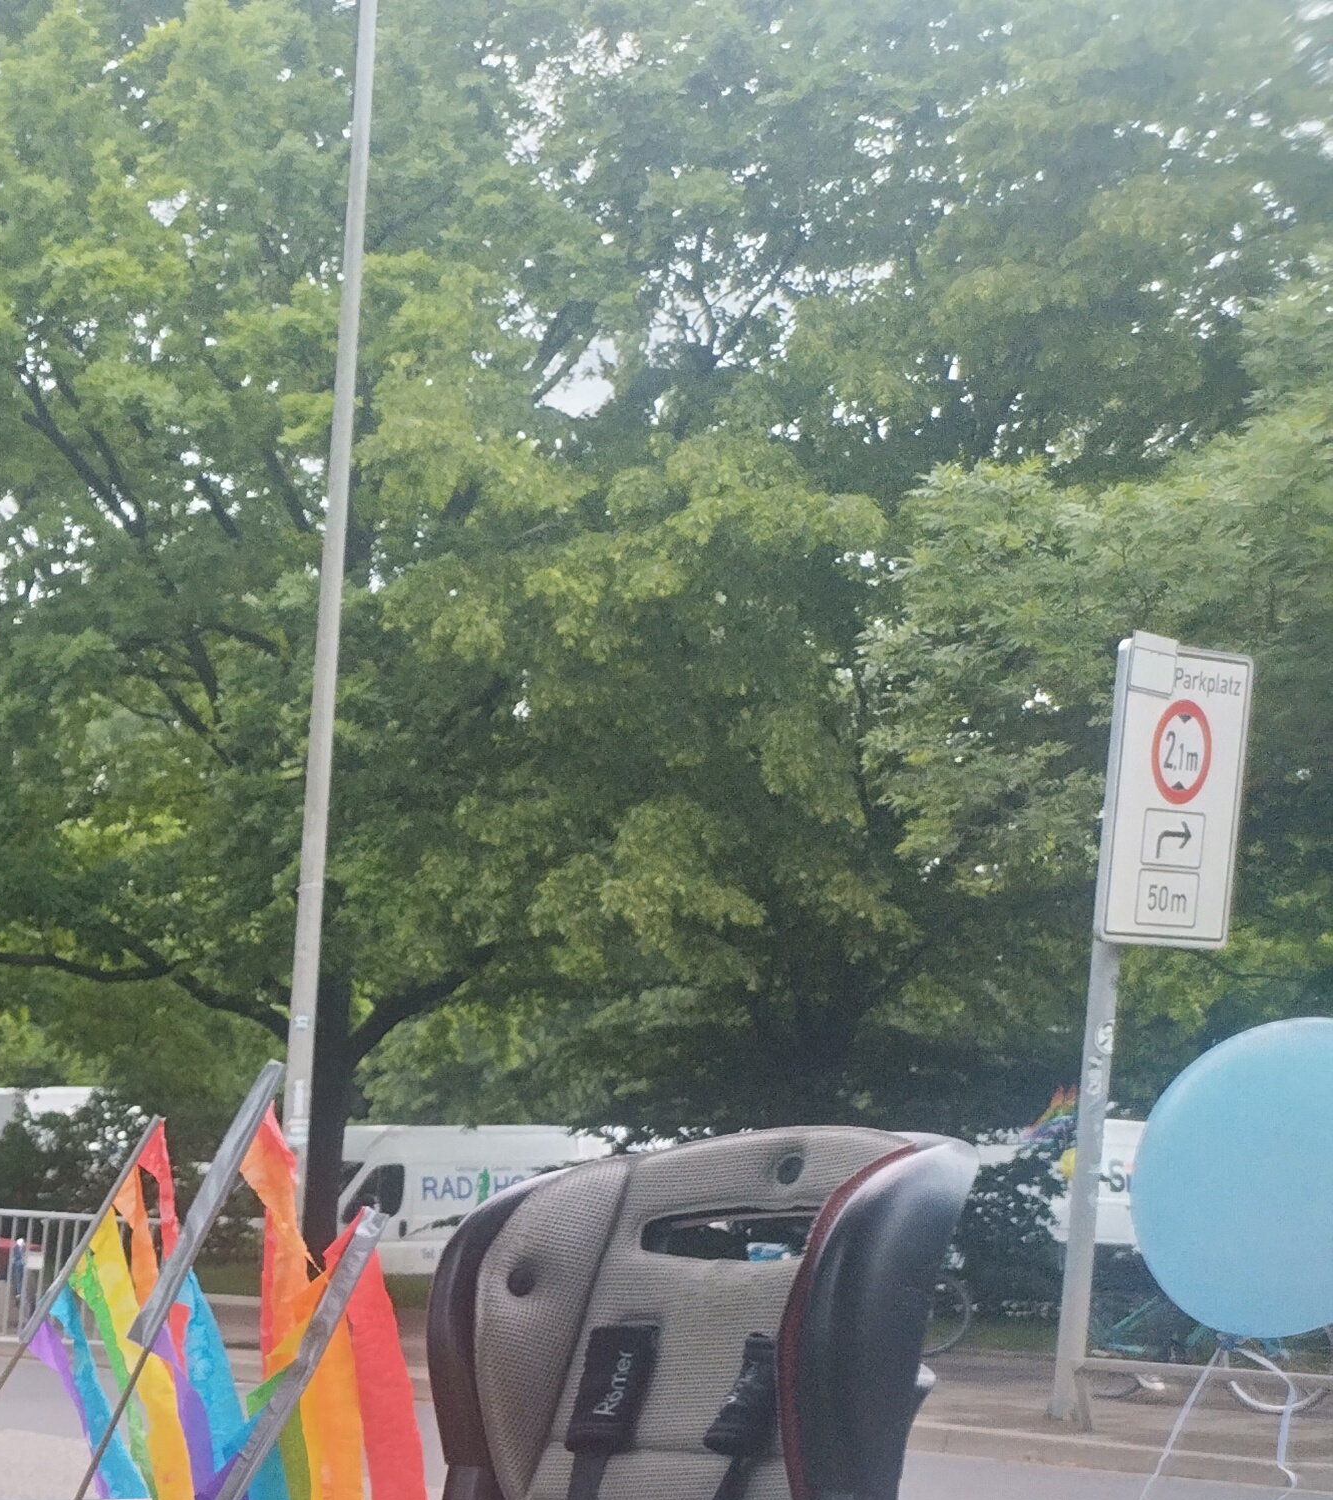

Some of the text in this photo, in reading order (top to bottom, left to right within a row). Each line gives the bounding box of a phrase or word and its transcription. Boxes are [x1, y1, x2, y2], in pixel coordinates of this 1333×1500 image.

[1174, 666, 1242, 698] Parkplatz
[1147, 883, 1188, 913] 50m
[421, 1175, 473, 1201] RAD
[593, 1350, 634, 1416] Römer
